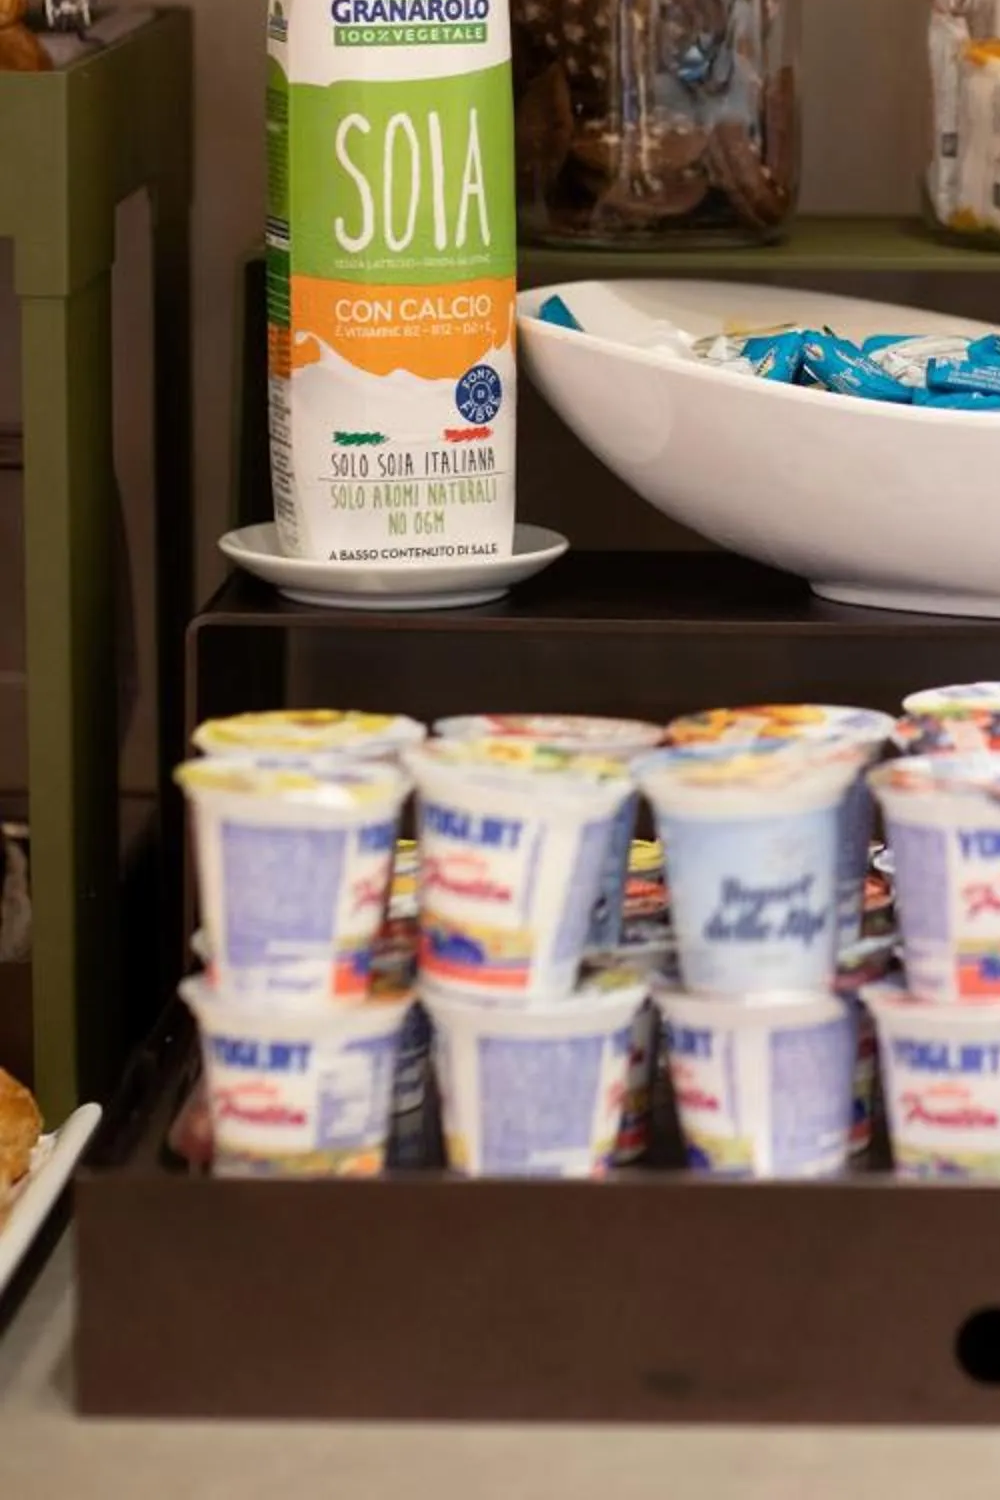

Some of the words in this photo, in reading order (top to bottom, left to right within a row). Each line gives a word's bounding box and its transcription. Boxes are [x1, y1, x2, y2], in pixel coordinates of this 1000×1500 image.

[334, 107, 491, 253] SOIA
[335, 300, 391, 323] CON
[400, 295, 492, 321] CALCIO
[332, 453, 368, 477] SOLO
[378, 452, 413, 477] SOIA
[425, 448, 495, 476] ITALIANA
[331, 484, 367, 510] SOLO
[374, 482, 419, 508] AROMI
[428, 478, 497, 506] NATURALI
[389, 513, 408, 535] NO
[415, 510, 445, 534] OGM
[329, 550, 337, 561] A
[340, 549, 378, 561] BASSO
[381, 546, 455, 560] CONTENUTO
[458, 545, 469, 556] DI
[472, 543, 498, 556] SALE
